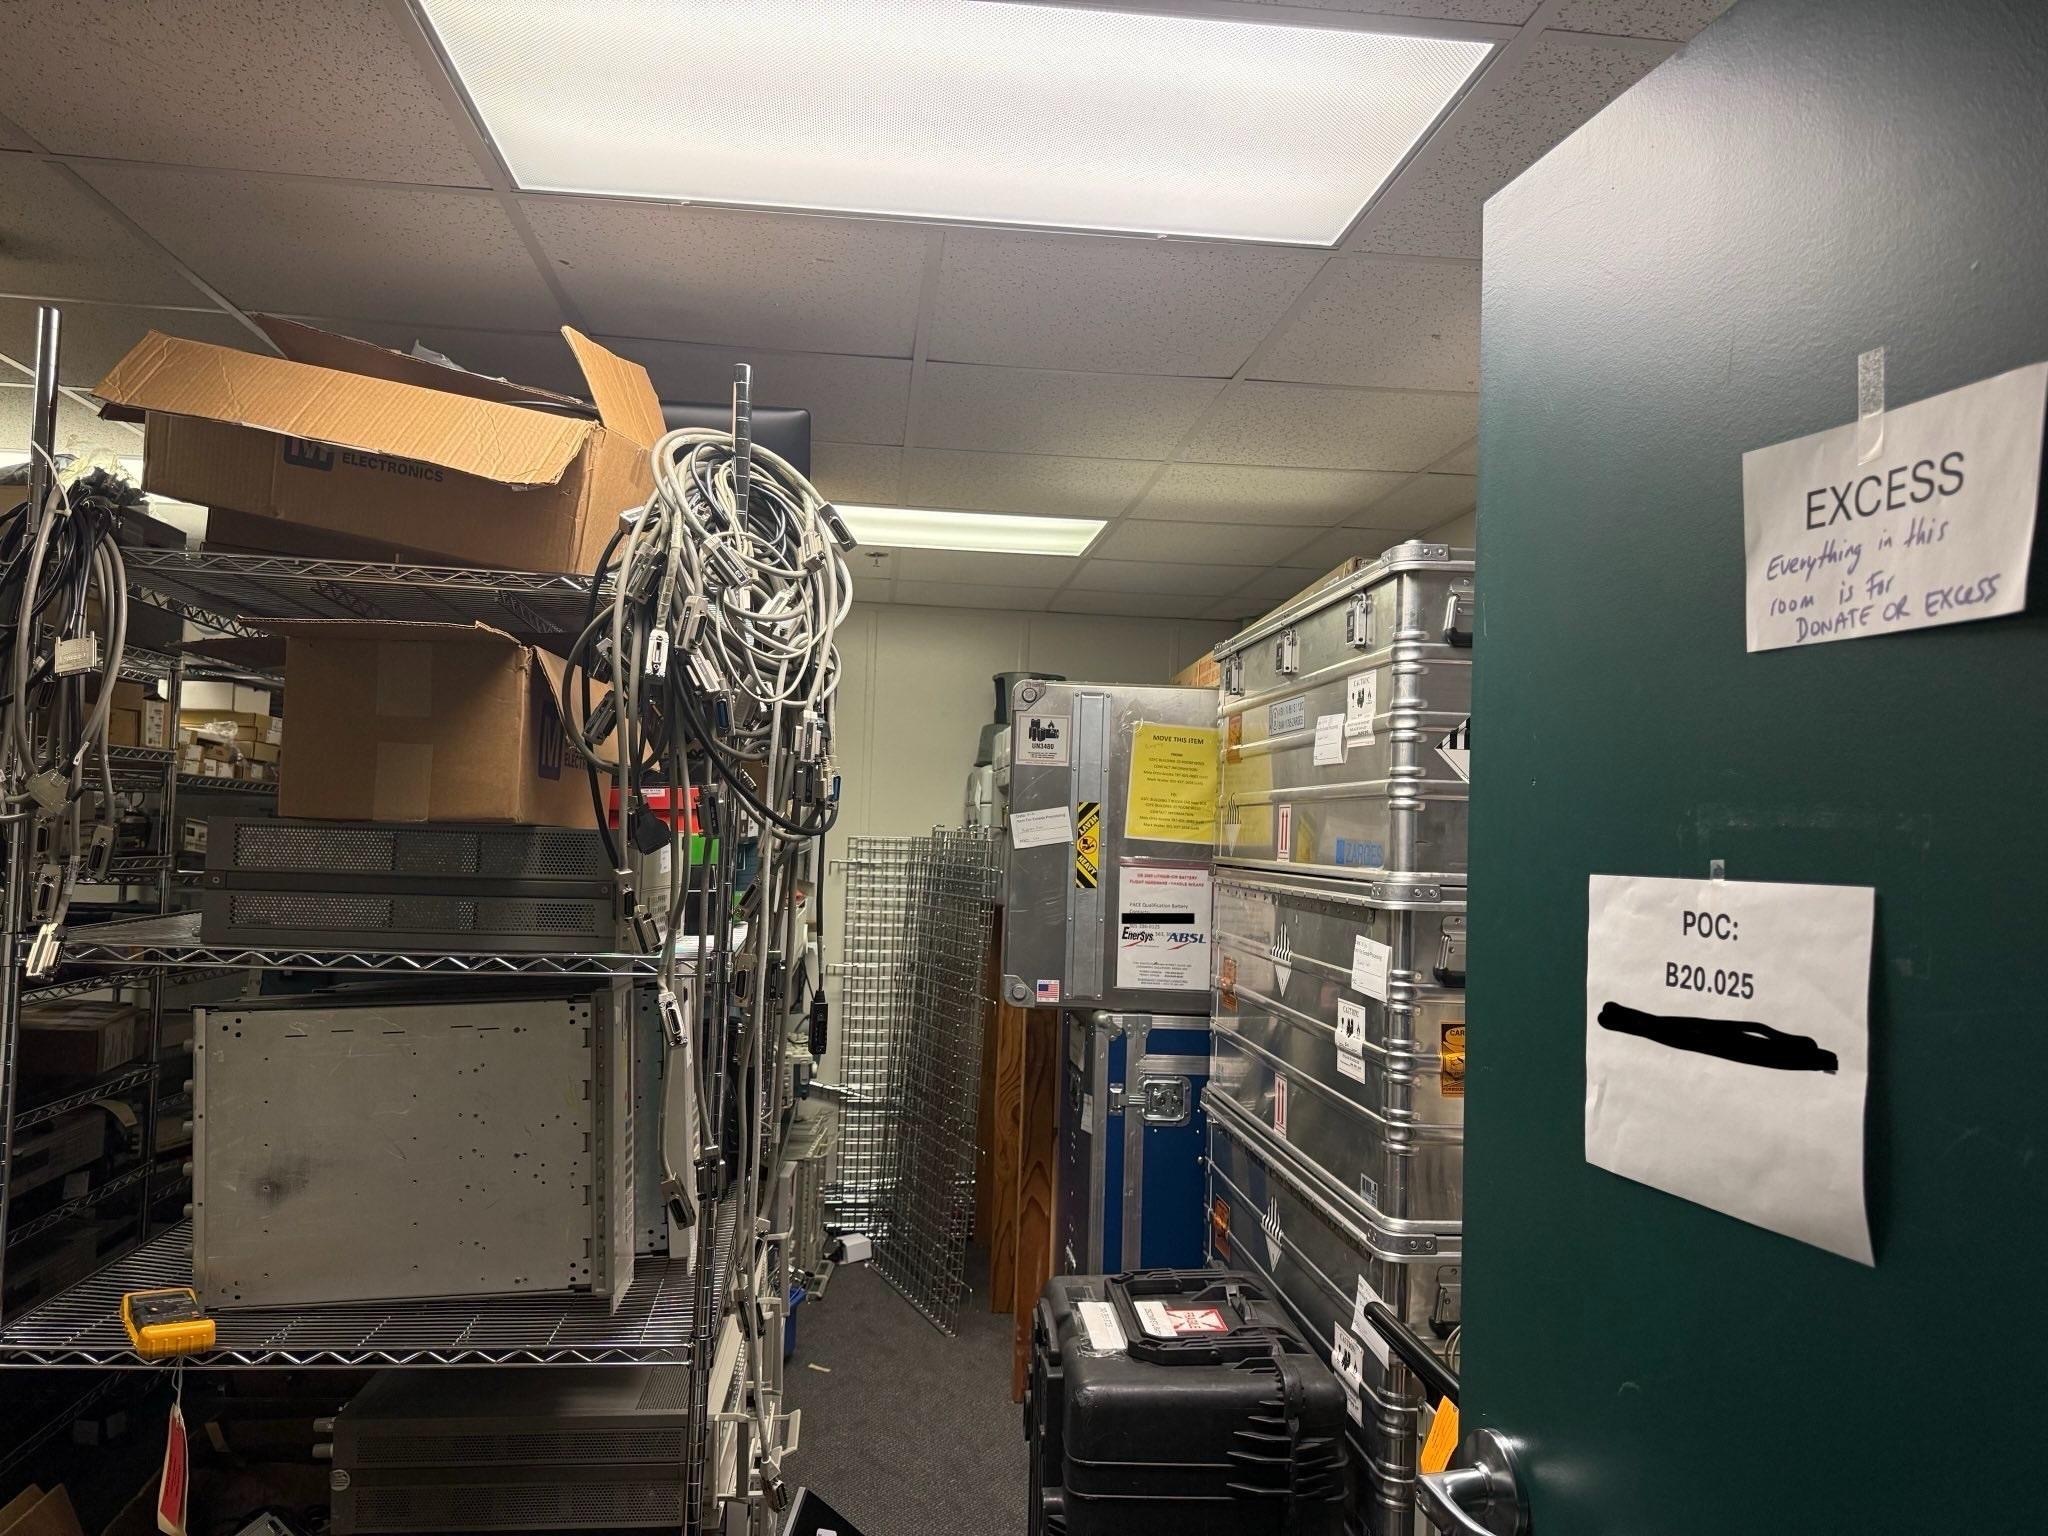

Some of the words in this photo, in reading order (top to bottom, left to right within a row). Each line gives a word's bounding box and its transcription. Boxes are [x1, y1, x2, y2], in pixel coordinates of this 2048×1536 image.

[342, 452, 443, 482] ELECTRONICS
[1806, 451, 1965, 530] EXCESS
[1766, 539, 1862, 582] Everything
[1878, 529, 1893, 550] in
[1904, 517, 1949, 548] this
[1839, 581, 1854, 605] is
[1796, 604, 1874, 644] DONATE
[1883, 596, 1911, 622] OR
[1153, 735, 1172, 743] MOVE
[1173, 736, 1187, 744] THIS
[1188, 737, 1204, 745] ITEM
[1079, 814, 1099, 835] HEAVY
[1077, 855, 1097, 875] HEAVY
[1121, 926, 1154, 943] EnerSys
[1167, 932, 1207, 944] ABSL
[1683, 910, 1739, 942] POC:
[1666, 961, 1755, 1000] B20.025
